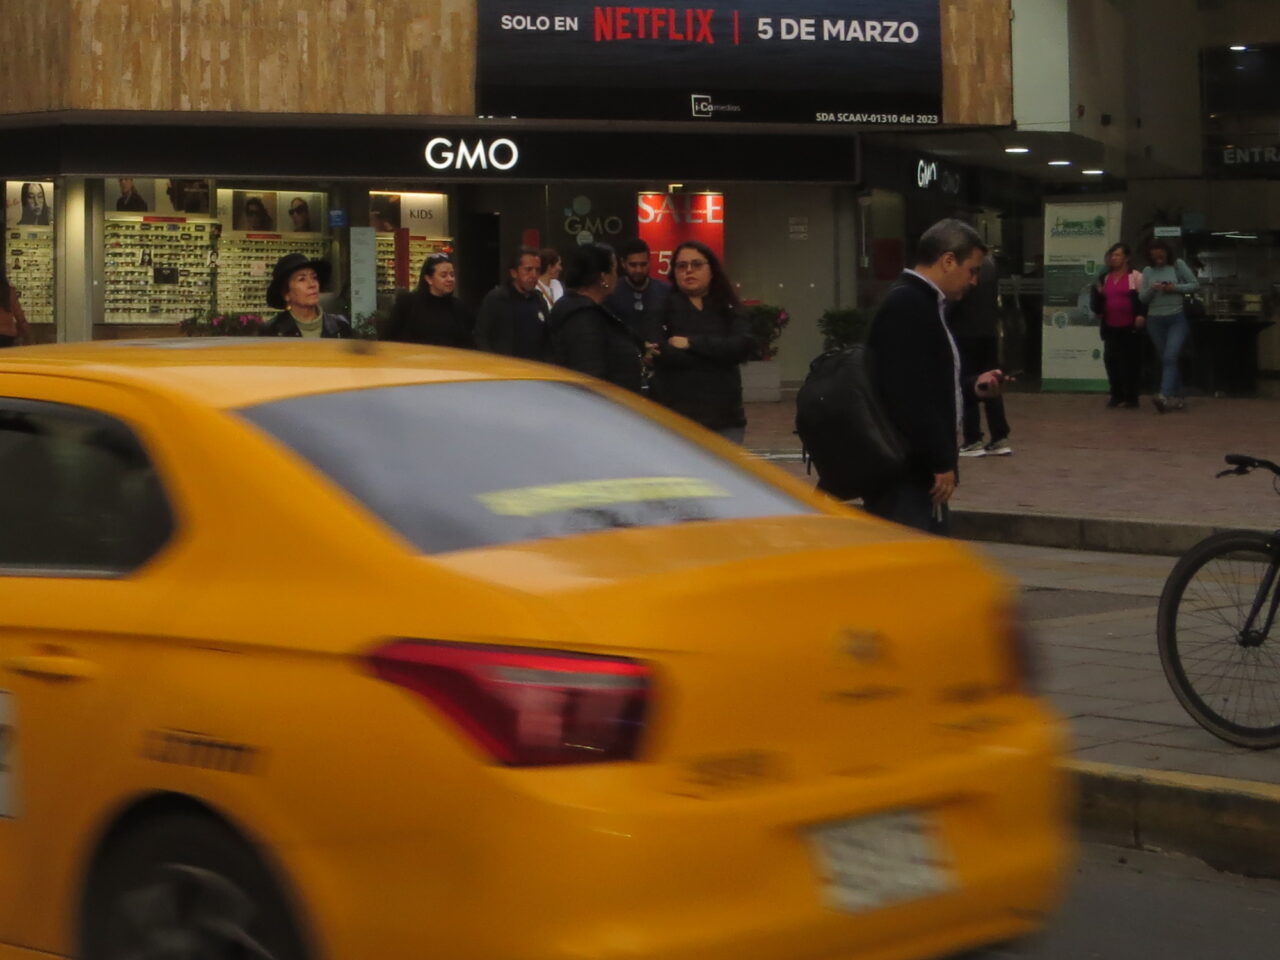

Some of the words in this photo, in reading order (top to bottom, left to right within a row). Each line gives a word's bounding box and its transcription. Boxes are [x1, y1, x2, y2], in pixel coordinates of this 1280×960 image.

[501, 15, 551, 31] SOLO
[554, 16, 578, 32] EN
[593, 7, 715, 44] NETFLIX
[757, 18, 774, 41] 5
[780, 18, 816, 42] DE
[823, 19, 919, 45] MARZO
[816, 112, 835, 122] SDA
[836, 113, 899, 124] SCAAV-01310
[900, 114, 915, 124] del
[916, 114, 939, 125] 2023
[424, 137, 519, 171] GMO
[1223, 148, 1280, 164] ENTR
[409, 207, 434, 221] KIDS
[638, 194, 724, 224] SALE
[564, 214, 623, 236] GMO
